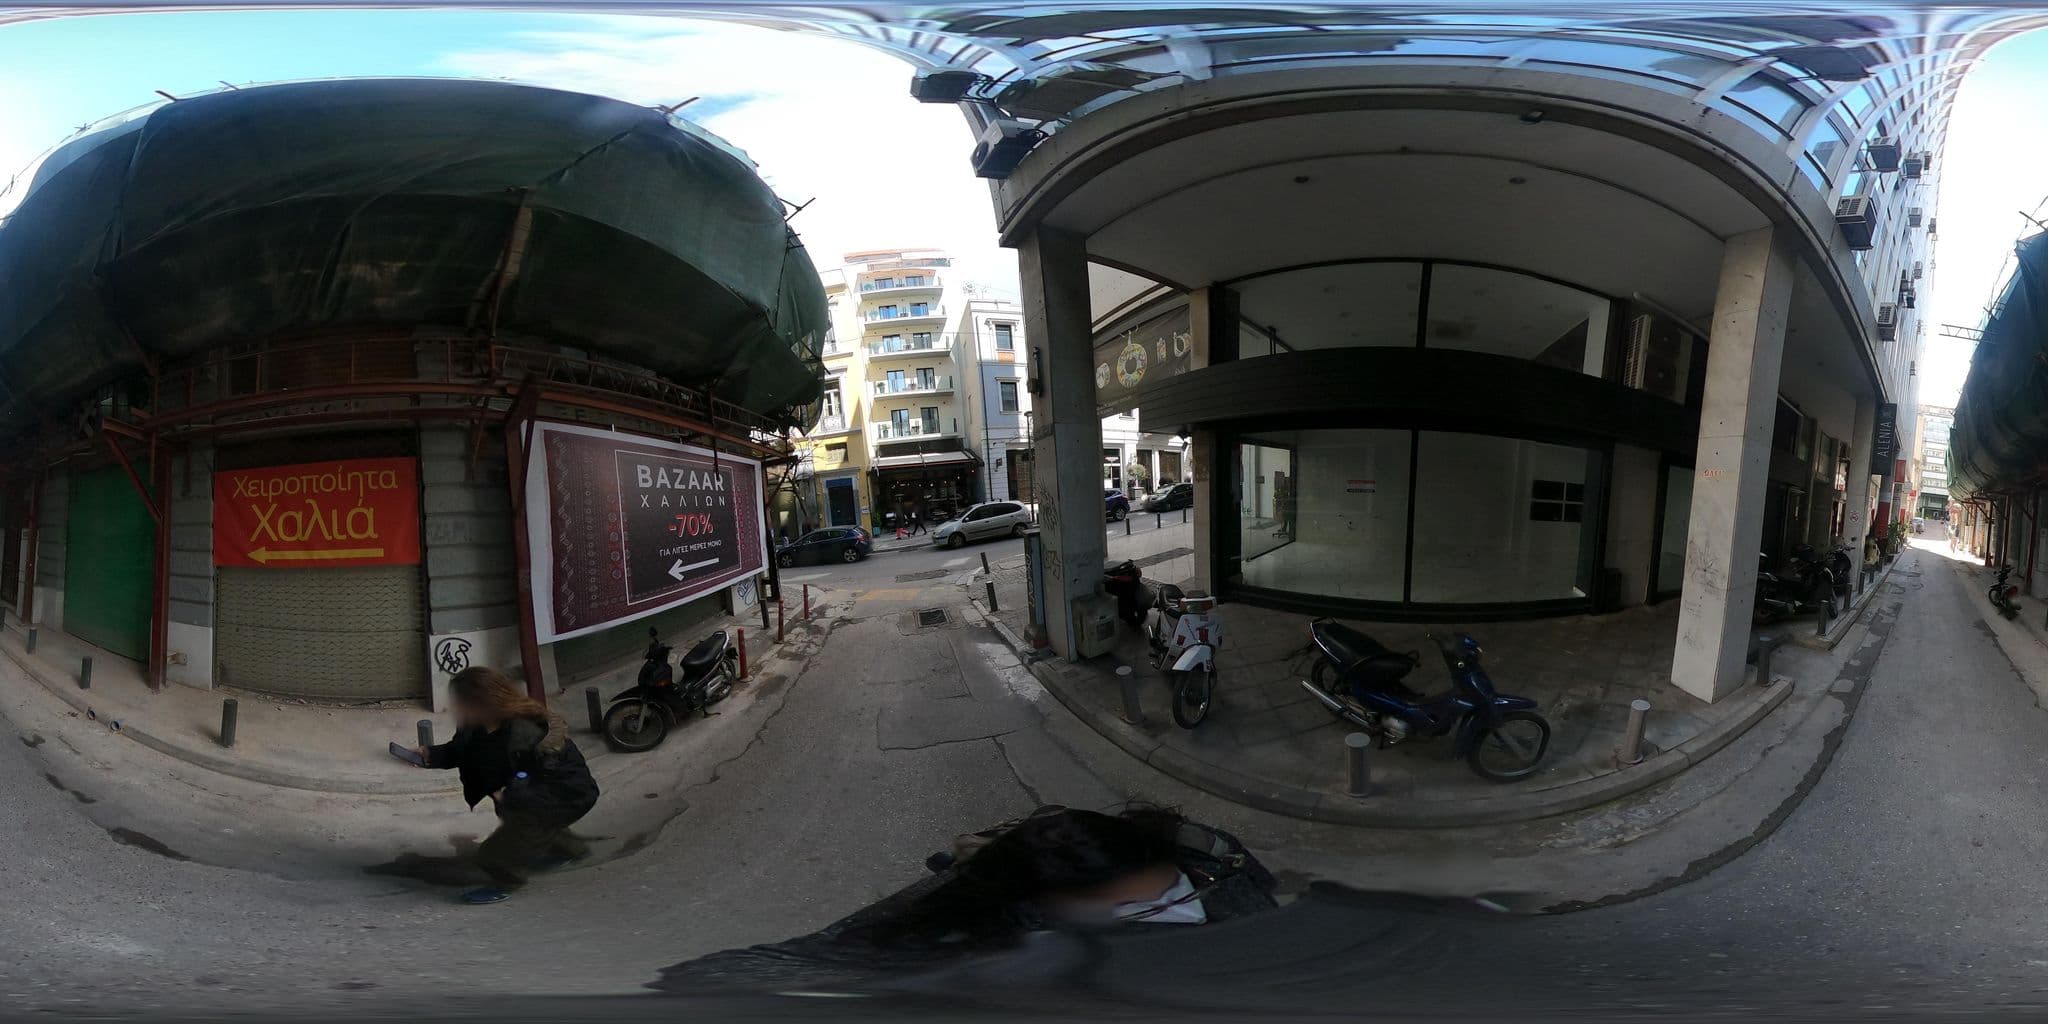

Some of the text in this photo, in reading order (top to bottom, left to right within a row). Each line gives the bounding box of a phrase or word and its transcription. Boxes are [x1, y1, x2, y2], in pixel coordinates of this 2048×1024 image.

[1877, 421, 1892, 457] ALENIA
[232, 465, 398, 502] Χειροποίητα
[636, 464, 725, 492] BAZAAR
[640, 494, 726, 508] ΧΑΛΙΩΝ
[250, 499, 378, 542] Χαλιά
[667, 512, 715, 538] -70%
